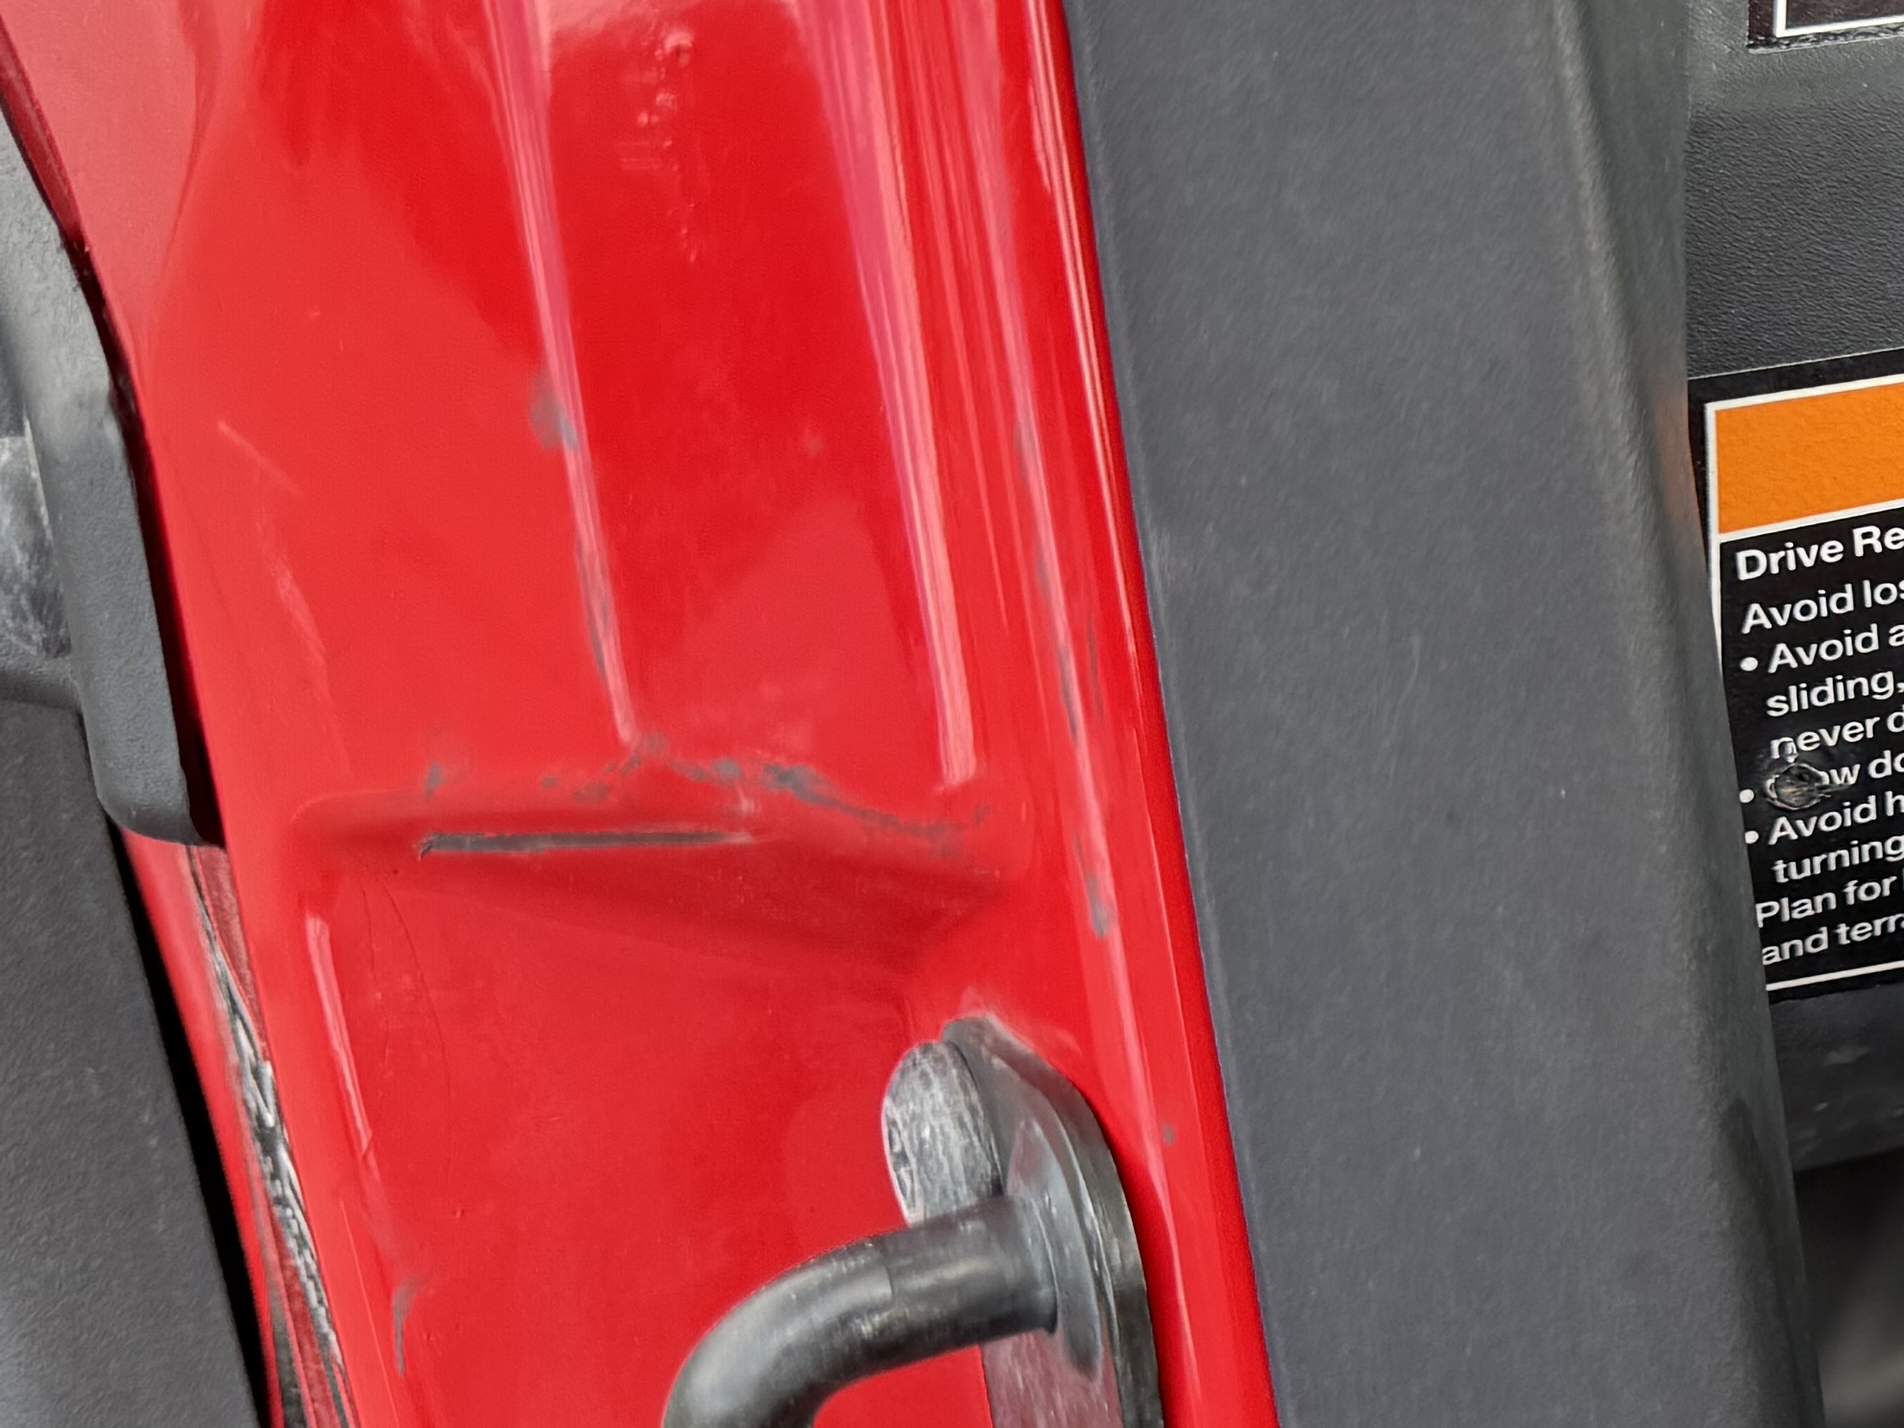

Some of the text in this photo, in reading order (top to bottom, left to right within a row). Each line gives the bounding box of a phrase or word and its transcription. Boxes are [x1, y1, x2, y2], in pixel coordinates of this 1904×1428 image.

[1736, 540, 1844, 580] Drive
[1742, 583, 1854, 634] Avoid
[1769, 623, 1879, 673] Avoid
[1767, 670, 1904, 717] sliding,
[1770, 717, 1880, 756] never
[1769, 795, 1877, 845] Avoid
[1756, 892, 1837, 928] Plan
[1843, 876, 1897, 905] for
[1761, 926, 1829, 965] and
